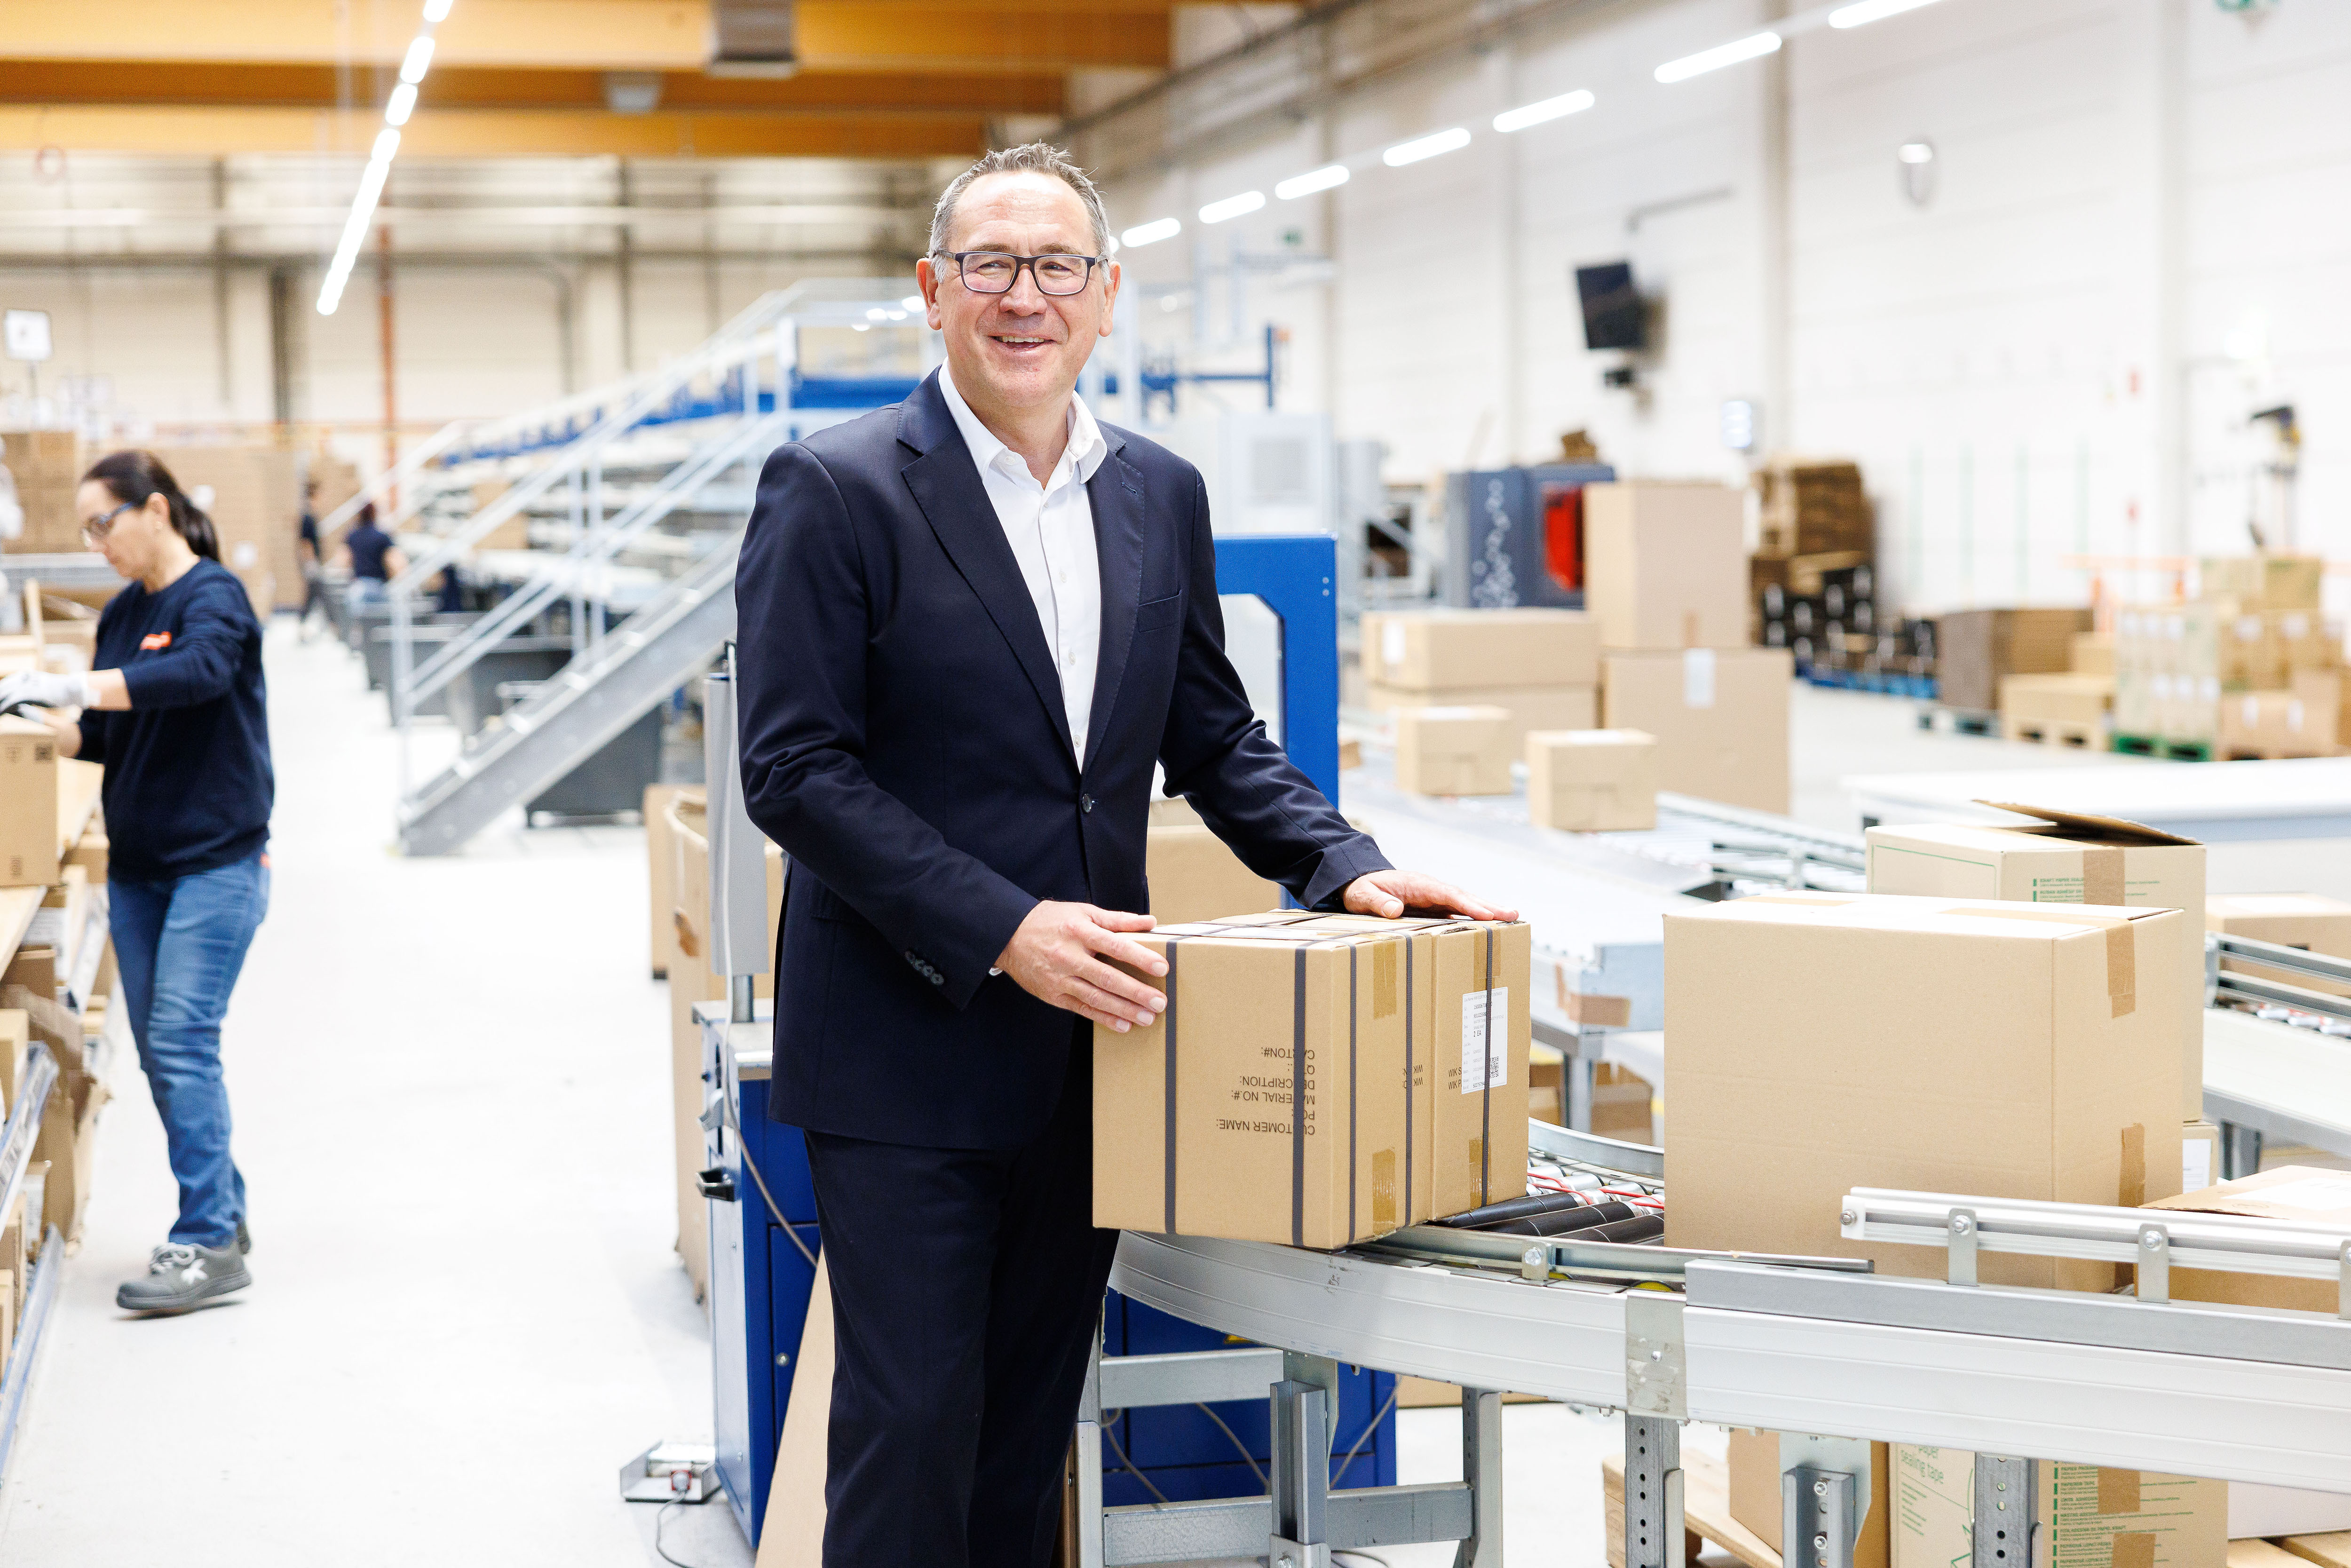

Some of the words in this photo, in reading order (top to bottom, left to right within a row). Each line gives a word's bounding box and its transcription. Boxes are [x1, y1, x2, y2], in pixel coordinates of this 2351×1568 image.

[1261, 1047, 1315, 1060] CTON#:
[1413, 1064, 1423, 1074] WIK
[1449, 1068, 1457, 1077] WIK
[1240, 1076, 1315, 1090] DCRIPTION:
[1413, 1077, 1423, 1086] WIK
[1449, 1080, 1457, 1090] WIK
[1262, 1092, 1315, 1105] MERIAL
[1216, 1119, 1250, 1131] NAME:
[1253, 1121, 1315, 1135] CTOMER
